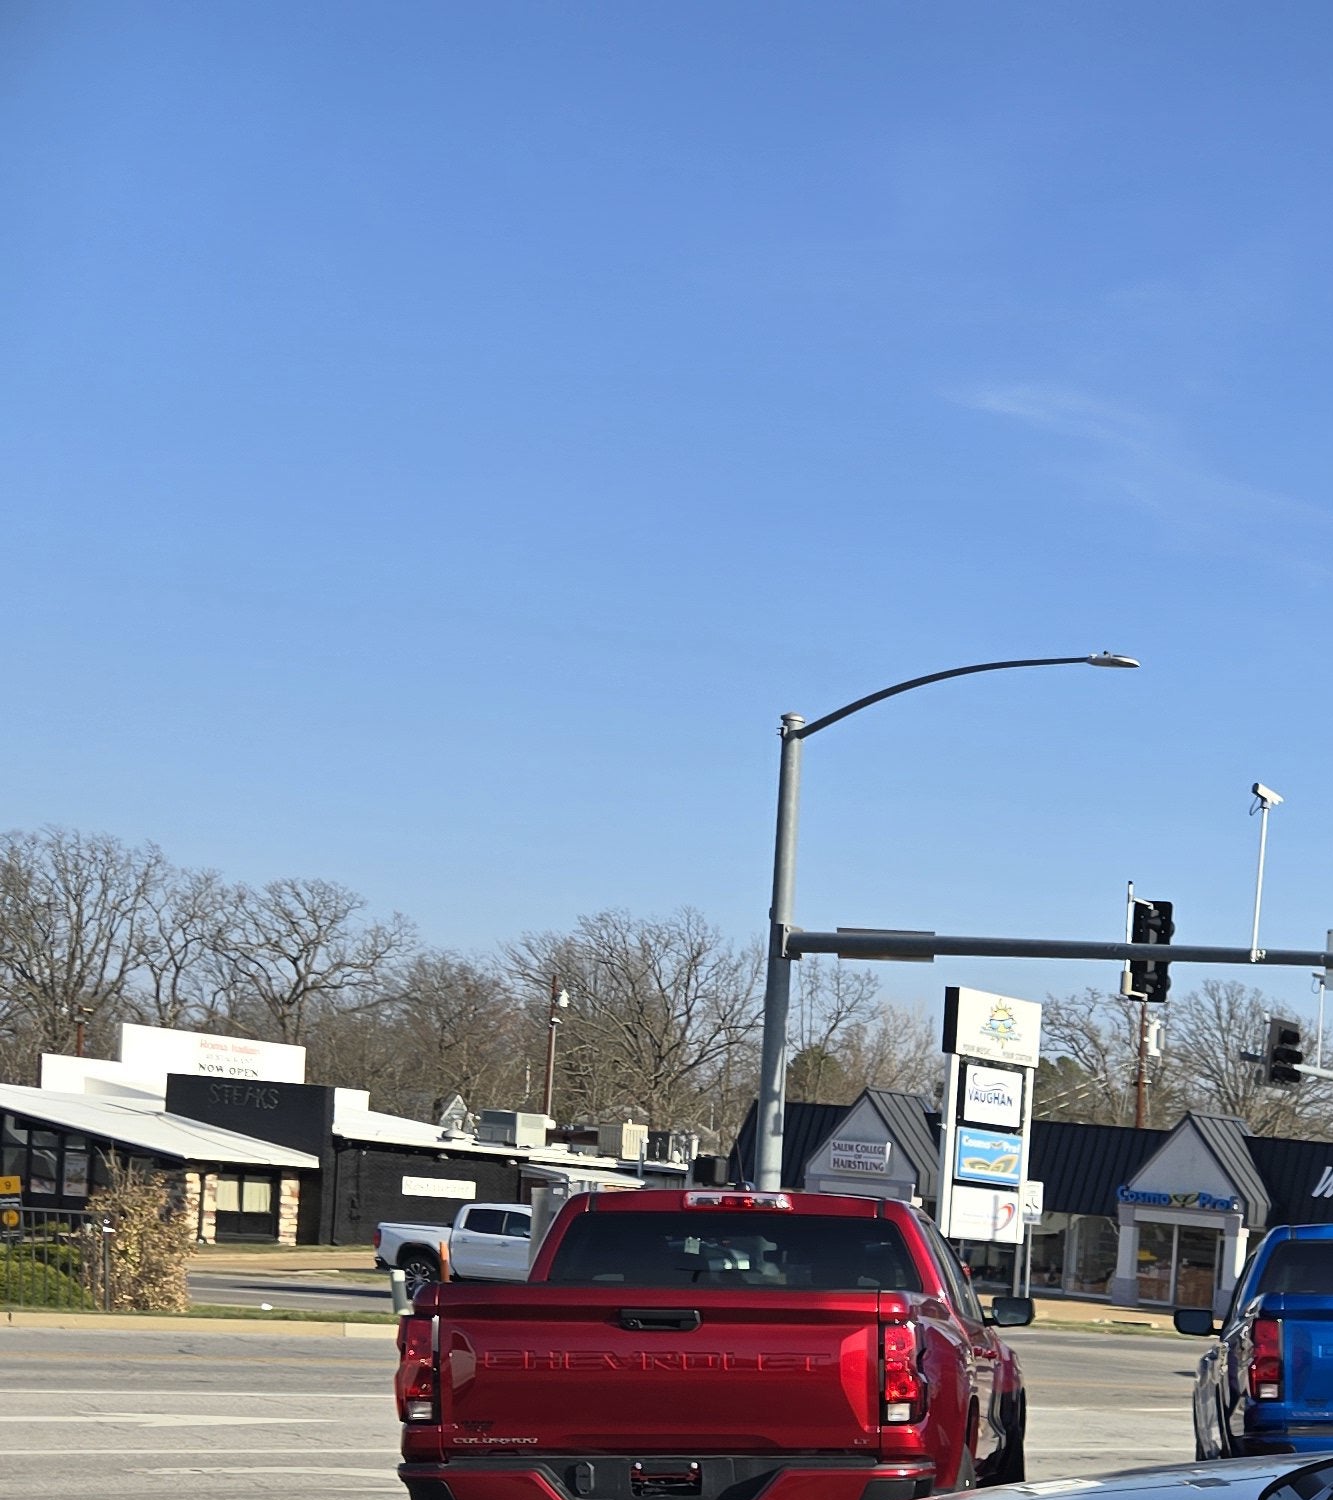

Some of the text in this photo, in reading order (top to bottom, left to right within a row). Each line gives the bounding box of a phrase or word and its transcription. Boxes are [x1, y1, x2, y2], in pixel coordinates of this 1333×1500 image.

[198, 1062, 259, 1078] NOW OPEN
[209, 1083, 280, 1110] STEAKS
[968, 1088, 1013, 1107] VAUGHAN
[832, 1141, 855, 1152] SALEM
[832, 1157, 885, 1172] HAIRSTYLING
[1117, 1184, 1170, 1205] Cosmo
[484, 1349, 831, 1372] CHEVROLET
